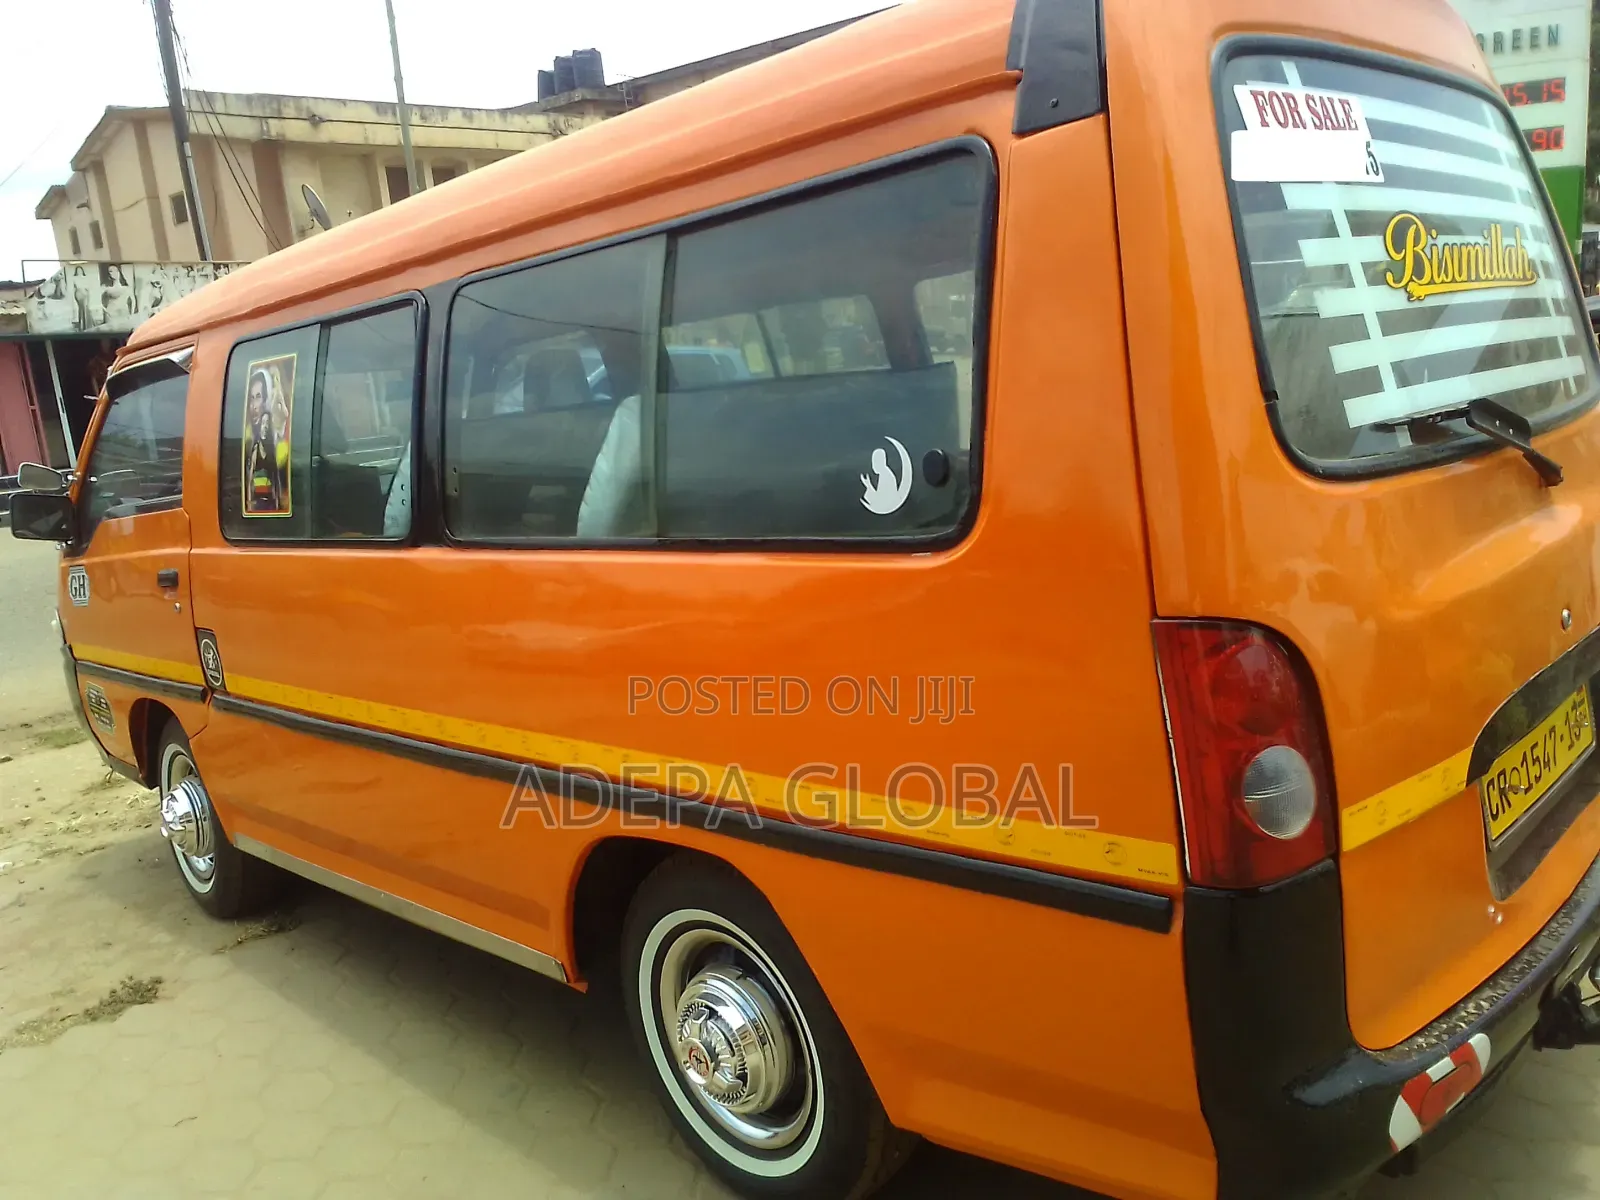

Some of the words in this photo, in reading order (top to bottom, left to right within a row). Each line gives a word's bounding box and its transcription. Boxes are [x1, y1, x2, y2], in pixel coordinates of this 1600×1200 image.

[1250, 90, 1306, 129] FOR
[1305, 93, 1359, 131] SALE
[1384, 211, 1535, 294] Bismillah
[70, 575, 87, 599] GH
[1486, 768, 1511, 822] CR
